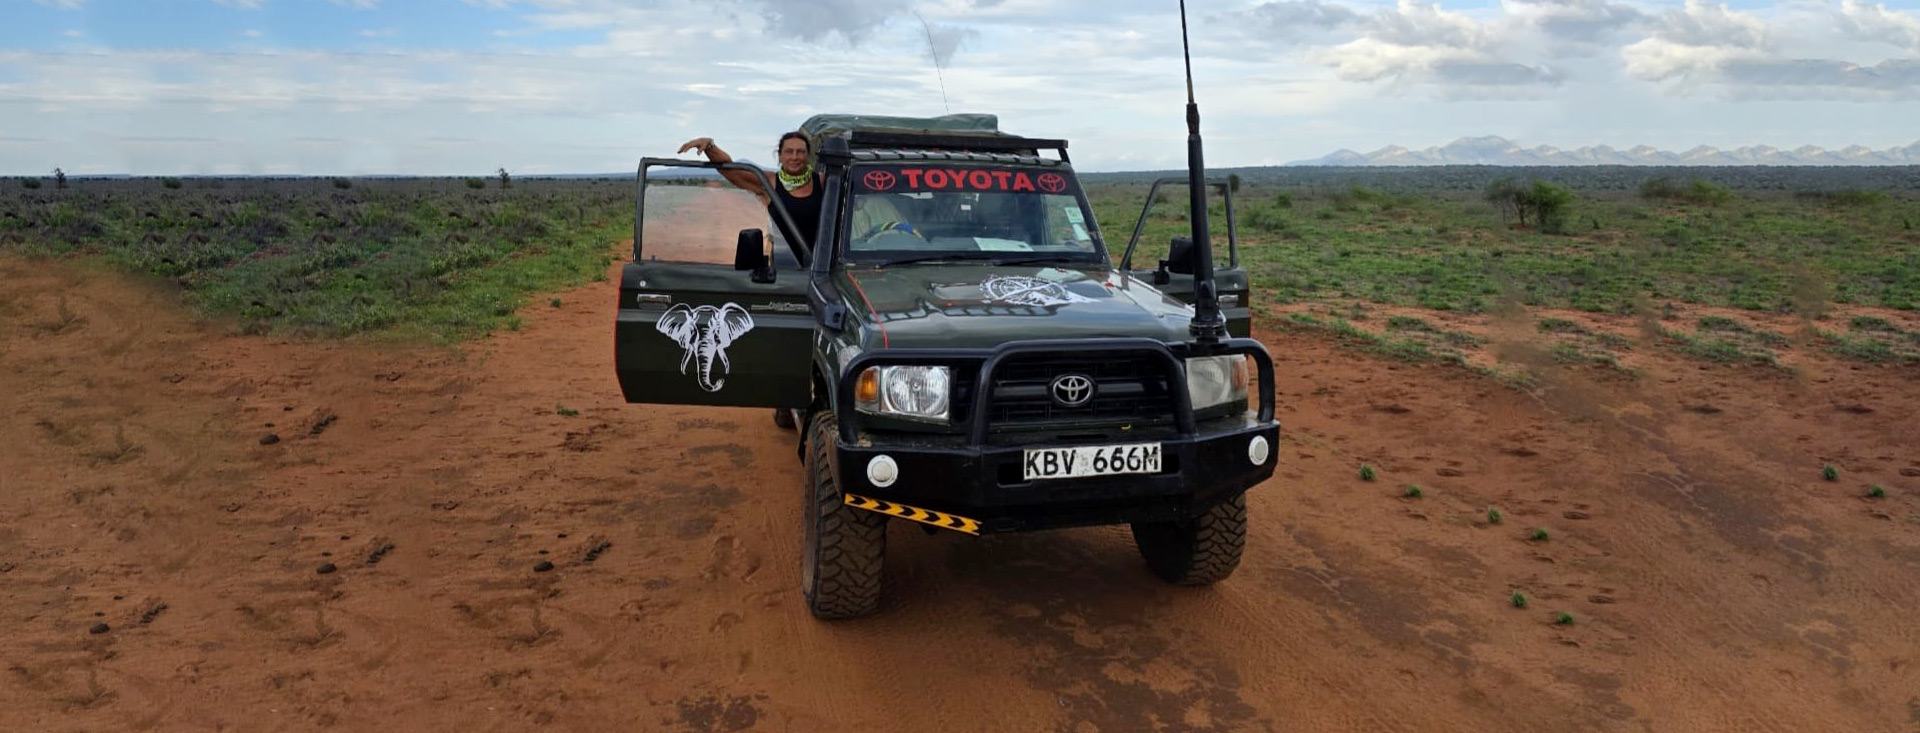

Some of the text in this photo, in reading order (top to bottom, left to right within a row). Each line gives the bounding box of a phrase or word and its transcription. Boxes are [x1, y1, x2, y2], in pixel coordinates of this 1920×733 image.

[901, 168, 1036, 192] TOYOTA
[1025, 446, 1159, 477] KBV 666M
